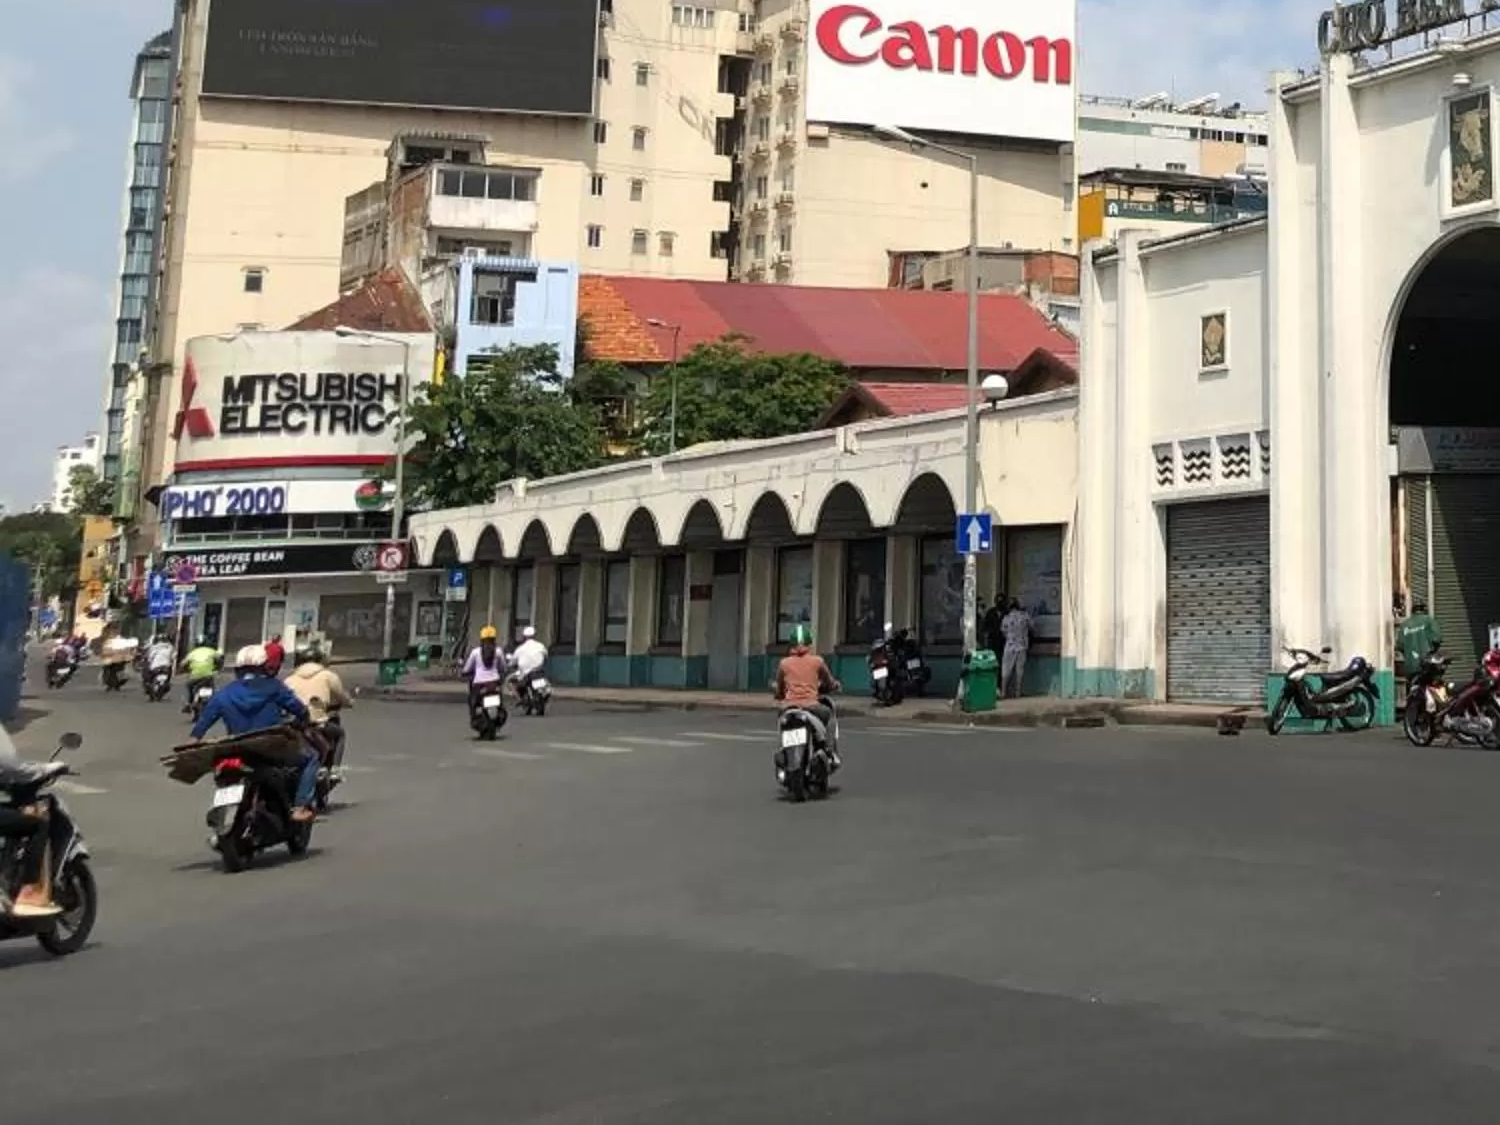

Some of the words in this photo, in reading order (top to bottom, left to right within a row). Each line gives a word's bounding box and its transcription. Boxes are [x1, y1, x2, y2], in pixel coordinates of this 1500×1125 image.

[816, 4, 1072, 85] Canon
[222, 372, 406, 404] MITSUBISH
[220, 403, 386, 435] ELECTRIC
[226, 486, 285, 515] 2000
[209, 553, 250, 564] COFFEE
[253, 551, 285, 562] BEAN
[219, 563, 248, 574] LEAF
